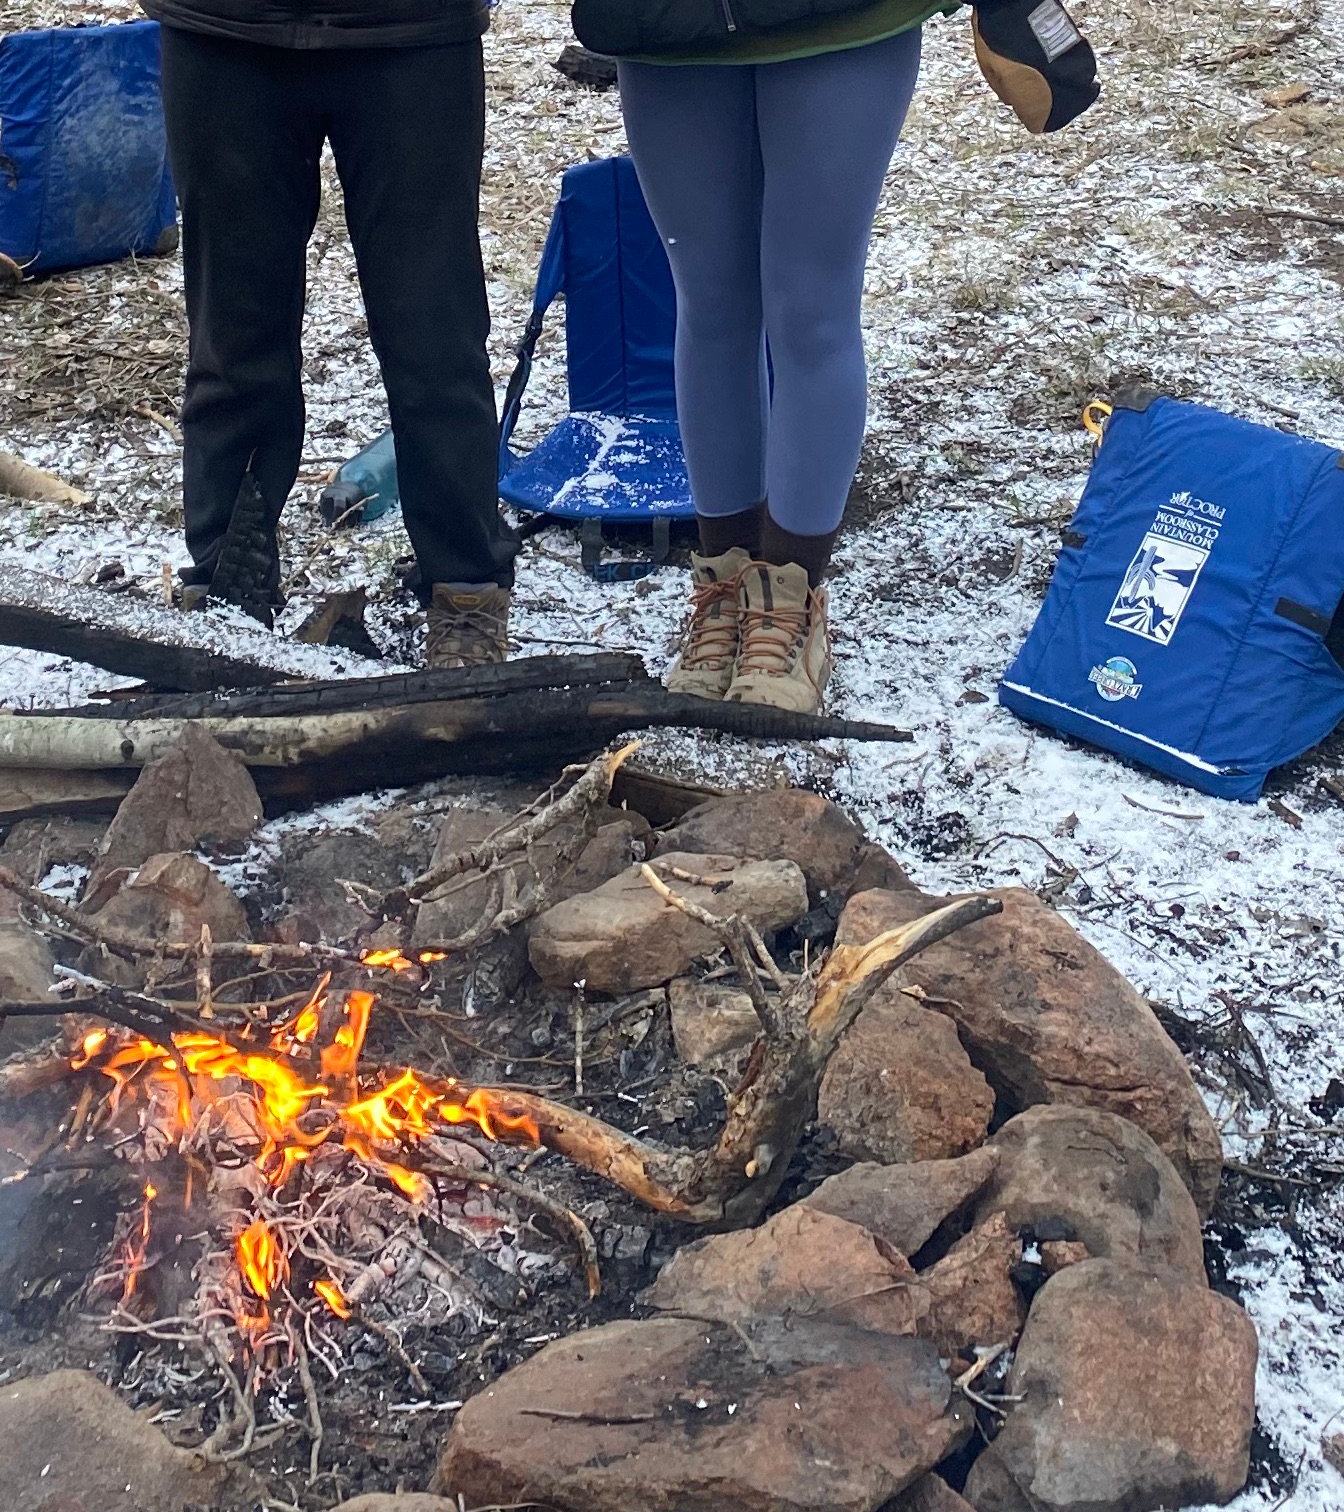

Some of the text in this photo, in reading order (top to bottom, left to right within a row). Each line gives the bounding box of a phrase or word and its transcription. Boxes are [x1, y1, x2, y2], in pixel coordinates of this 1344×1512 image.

[1169, 491, 1226, 520] PROCTOR
[1150, 522, 1214, 550] MOUNTAIN
[1155, 511, 1219, 540] CLASSROOM
